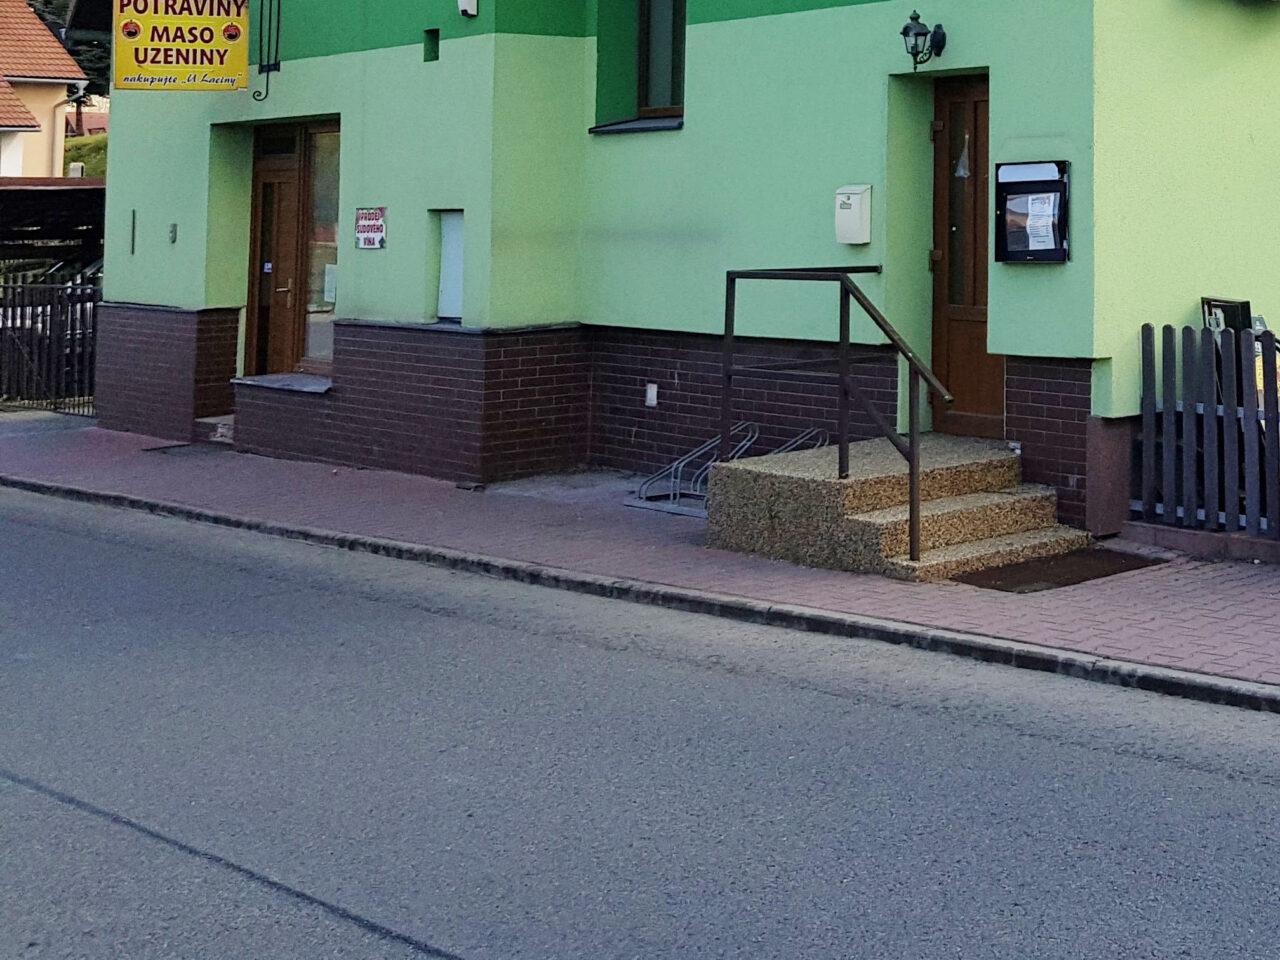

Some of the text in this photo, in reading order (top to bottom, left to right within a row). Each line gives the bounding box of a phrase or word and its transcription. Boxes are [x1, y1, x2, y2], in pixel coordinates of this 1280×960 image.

[150, 25, 214, 44] MASO
[134, 47, 229, 65] UZENINY
[123, 73, 178, 86] nakupujte
